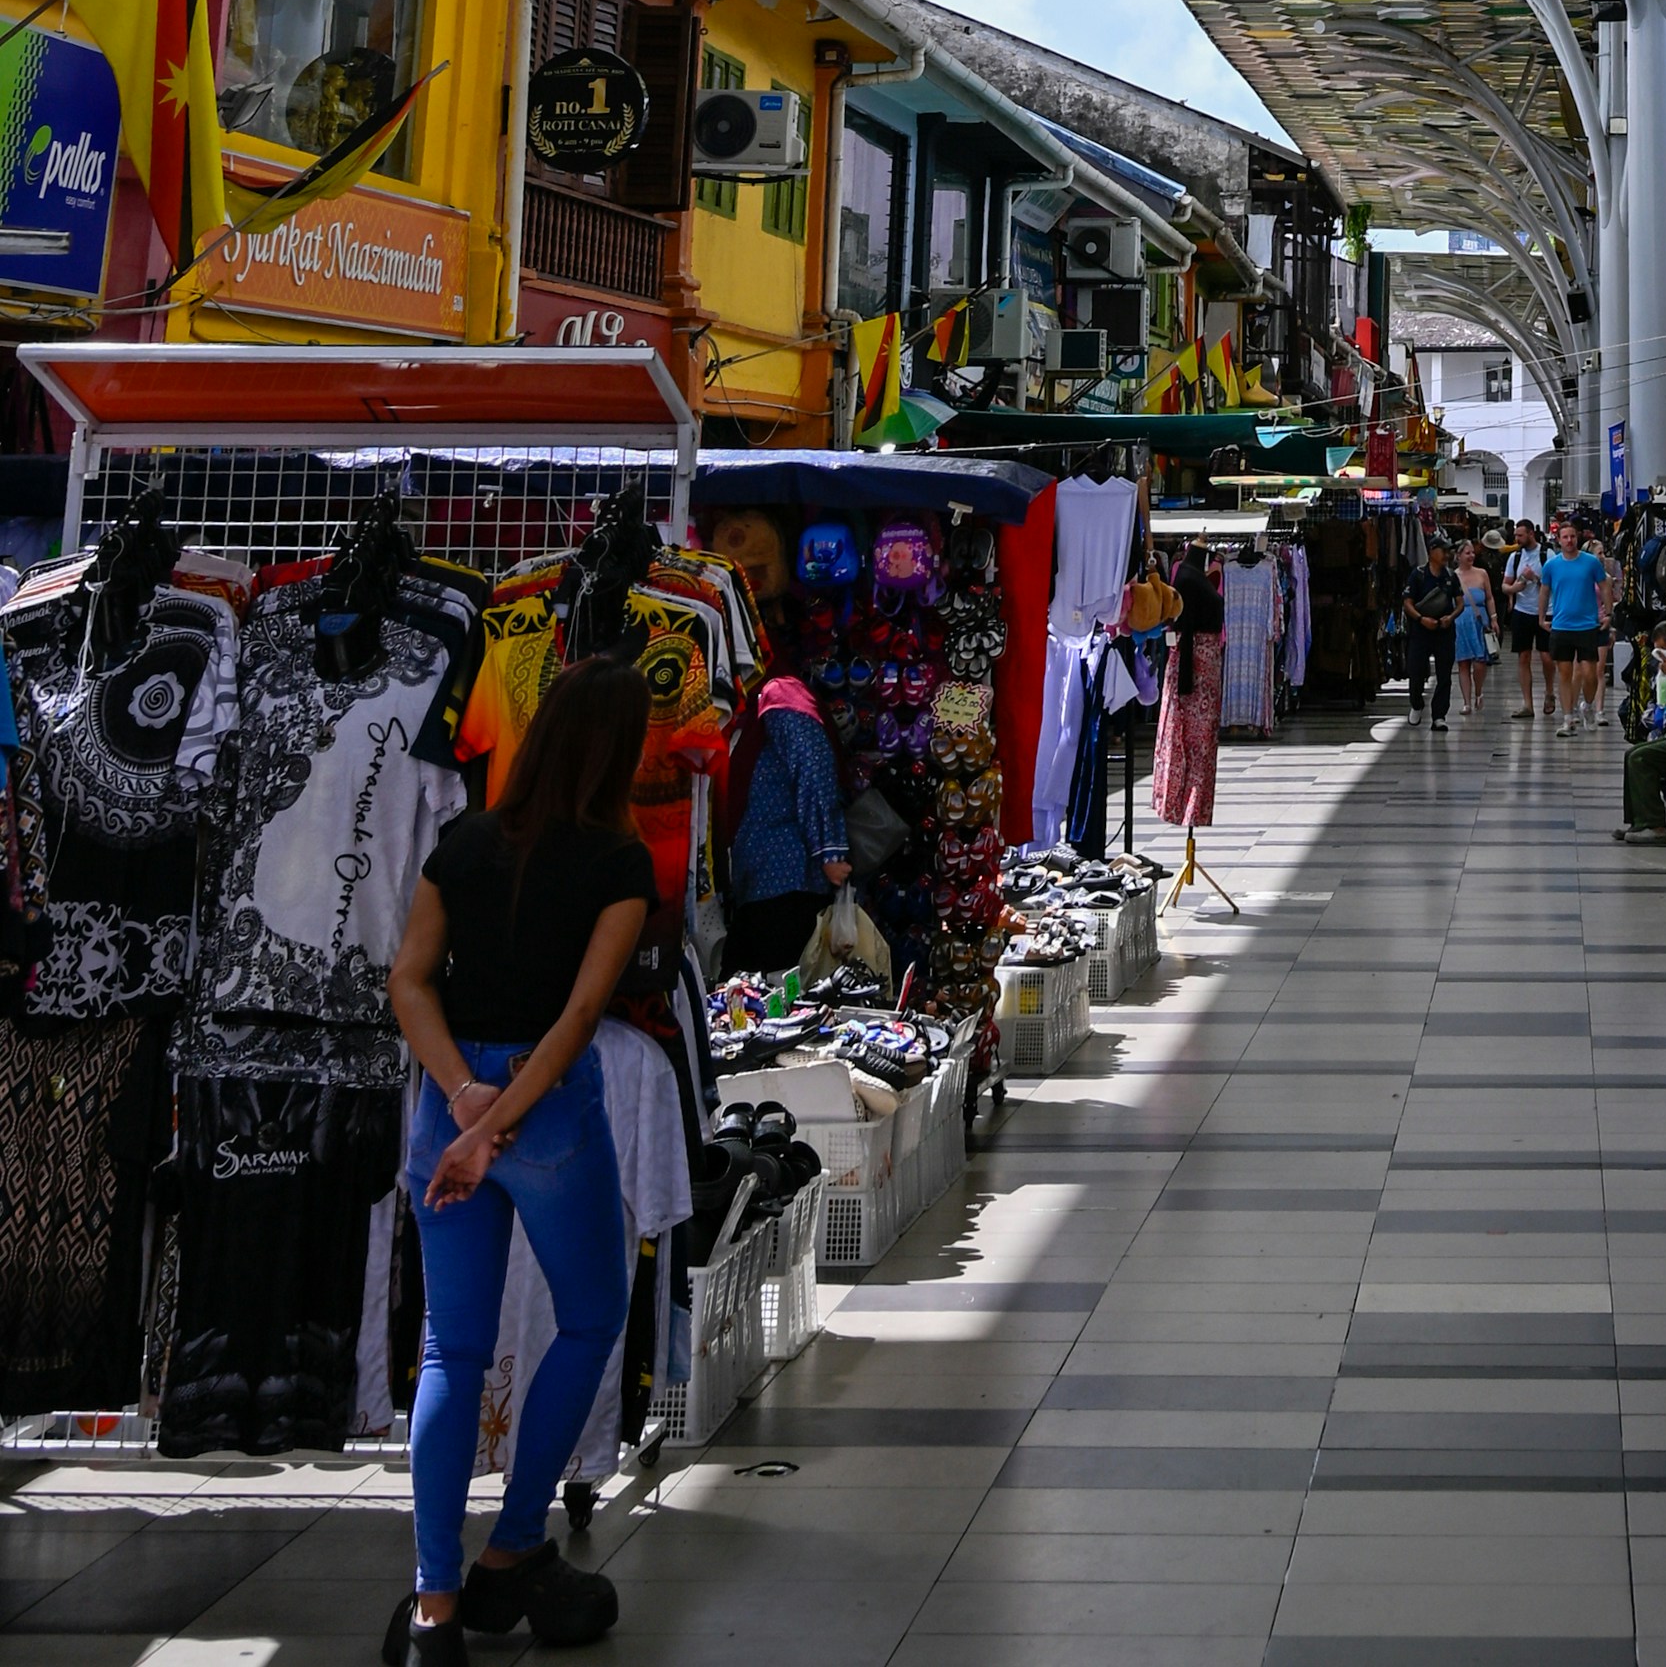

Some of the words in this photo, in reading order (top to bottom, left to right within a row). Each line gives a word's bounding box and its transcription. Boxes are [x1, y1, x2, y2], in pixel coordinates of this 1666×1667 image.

[542, 120, 576, 131] ROTI
[578, 120, 621, 131] CANAI
[39, 131, 106, 199] pallas
[324, 221, 443, 295] Naazimudin
[18, 643, 51, 659] awak
[353, 717, 408, 847] Sarawak
[331, 852, 371, 956] Borneo
